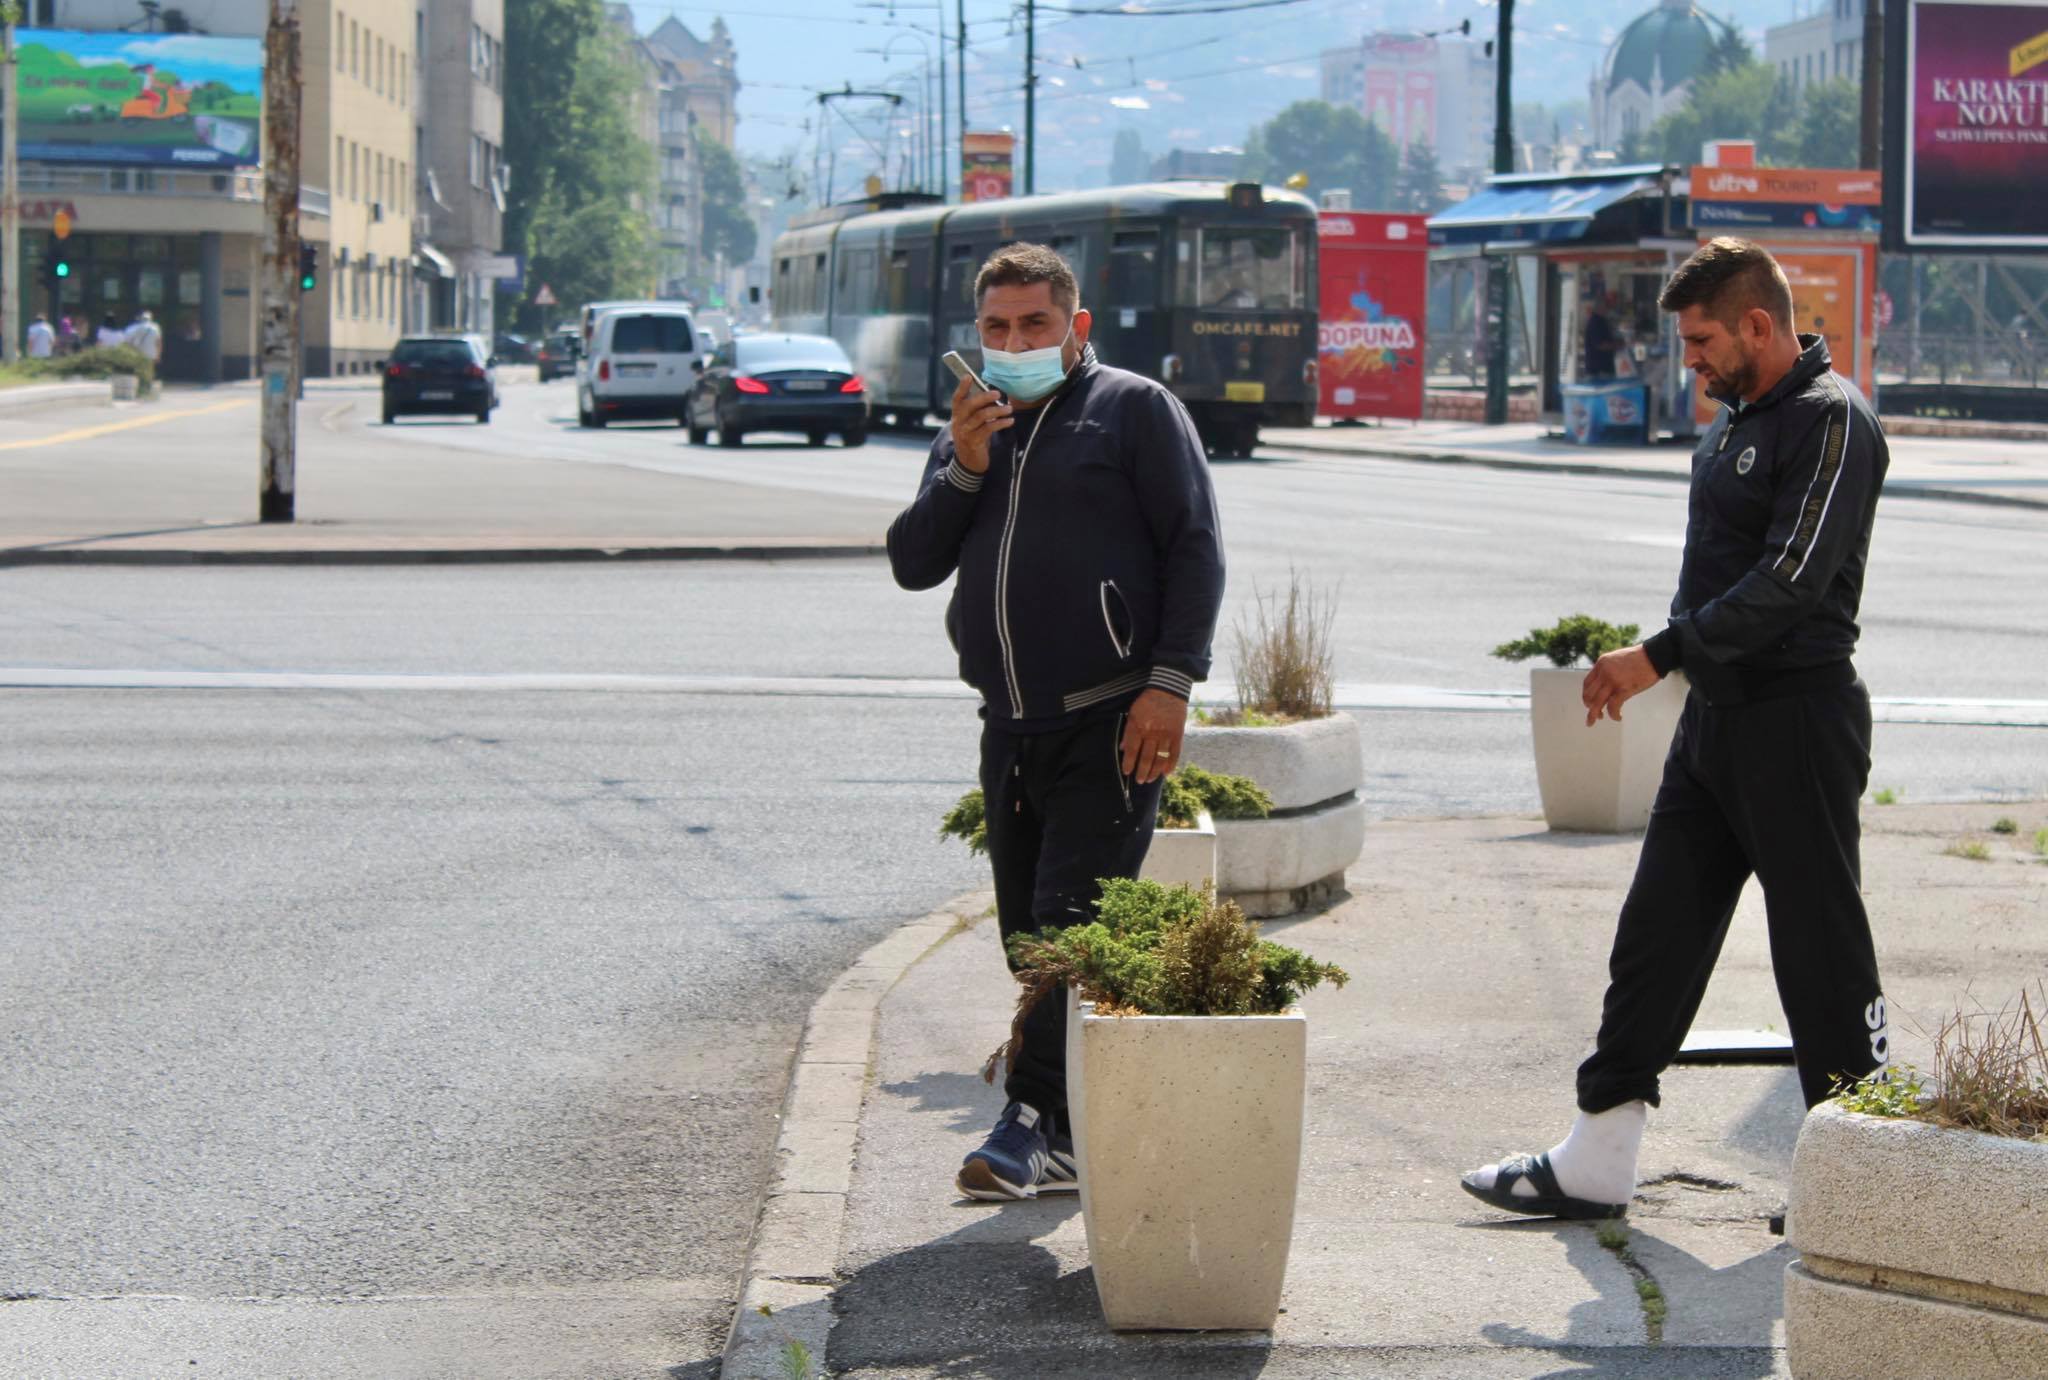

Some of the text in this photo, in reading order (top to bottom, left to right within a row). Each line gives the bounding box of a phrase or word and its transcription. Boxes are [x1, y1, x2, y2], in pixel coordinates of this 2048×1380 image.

[1934, 79, 2048, 103] KARAKT
[1958, 102, 2035, 127] NOVU
[1764, 179, 1818, 193] TOURIST
[1193, 321, 1301, 336] OMCAFE.NET
